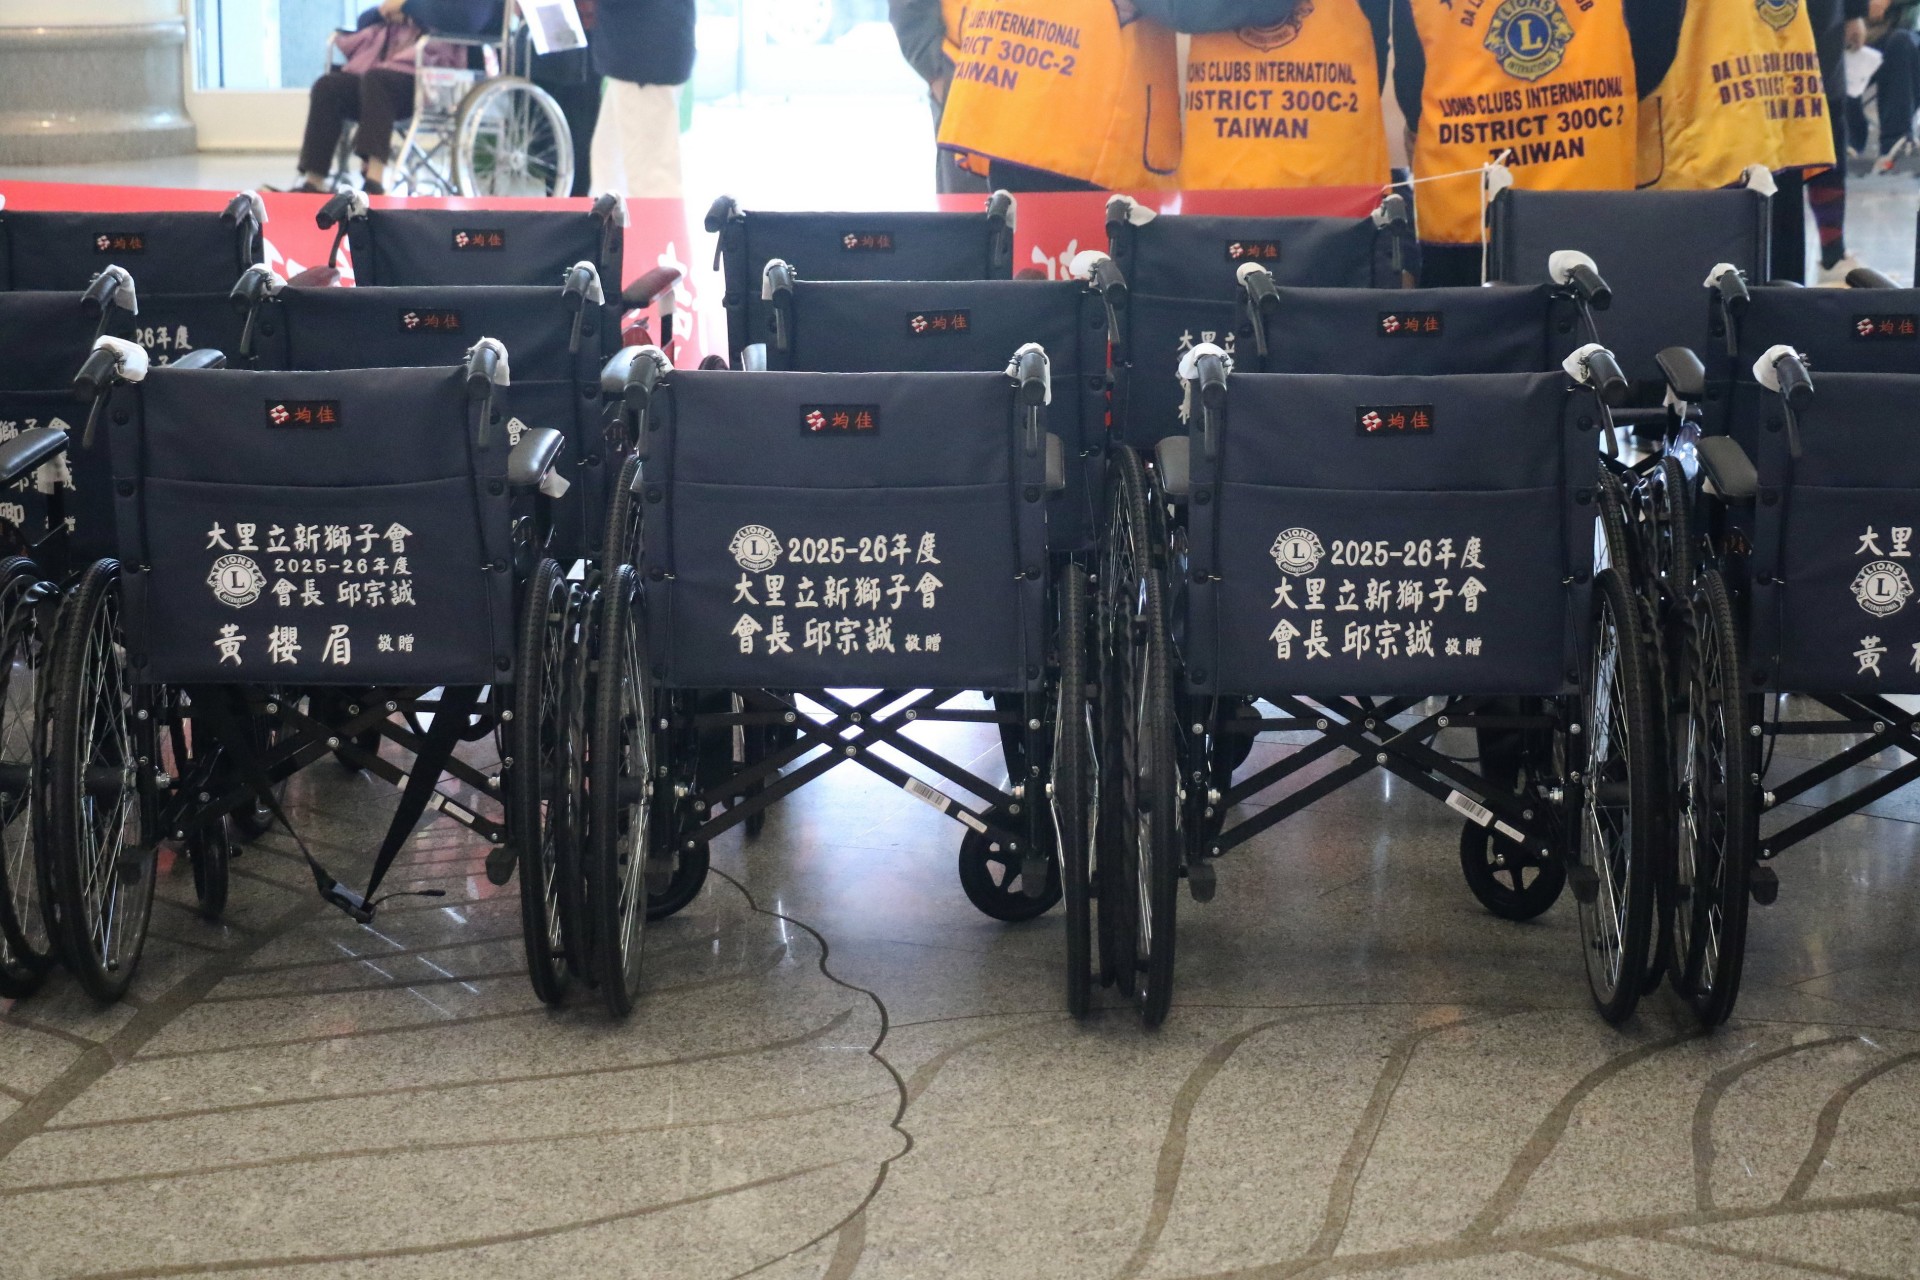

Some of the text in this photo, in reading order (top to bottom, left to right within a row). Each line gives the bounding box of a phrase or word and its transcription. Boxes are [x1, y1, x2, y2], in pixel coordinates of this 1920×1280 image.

[1460, 9, 1476, 27] DA
[1502, 0, 1551, 17] LIONS
[1518, 19, 1543, 51] L
[998, 40, 1075, 76] 300C-2
[956, 61, 1018, 90] AIWAN
[1208, 61, 1251, 82] CLUBS
[1711, 61, 1732, 83] DA
[1281, 90, 1358, 112] 300C-2
[1439, 76, 1622, 117] LIONS CLUBS INTERNATIONAL
[1214, 118, 1308, 138] TAIWAN
[1439, 115, 1548, 144] DISTRICT
[1489, 137, 1584, 168] TAIWAN
[295, 406, 335, 424] 均佳
[833, 412, 872, 429] 均佳
[1388, 412, 1429, 429] 均佳
[206, 521, 413, 554] 大里立新獅子會
[740, 526, 772, 538] LIONS
[1281, 530, 1314, 541] LIONS
[1854, 525, 1920, 557] 大里
[751, 540, 763, 555] L
[788, 531, 941, 565] 2025-26年度
[1292, 543, 1305, 558] L
[1331, 536, 1486, 570] 2025-26年度
[218, 556, 254, 568] LIONS
[274, 557, 413, 575] 2025-26年度
[1865, 563, 1901, 576] LIONS
[231, 571, 245, 588] L
[1875, 578, 1890, 596] L
[271, 578, 416, 607] 會長 邱宗誠
[732, 571, 943, 610] 大里立新獅子會
[1270, 576, 1487, 613] 大里立新獅子會
